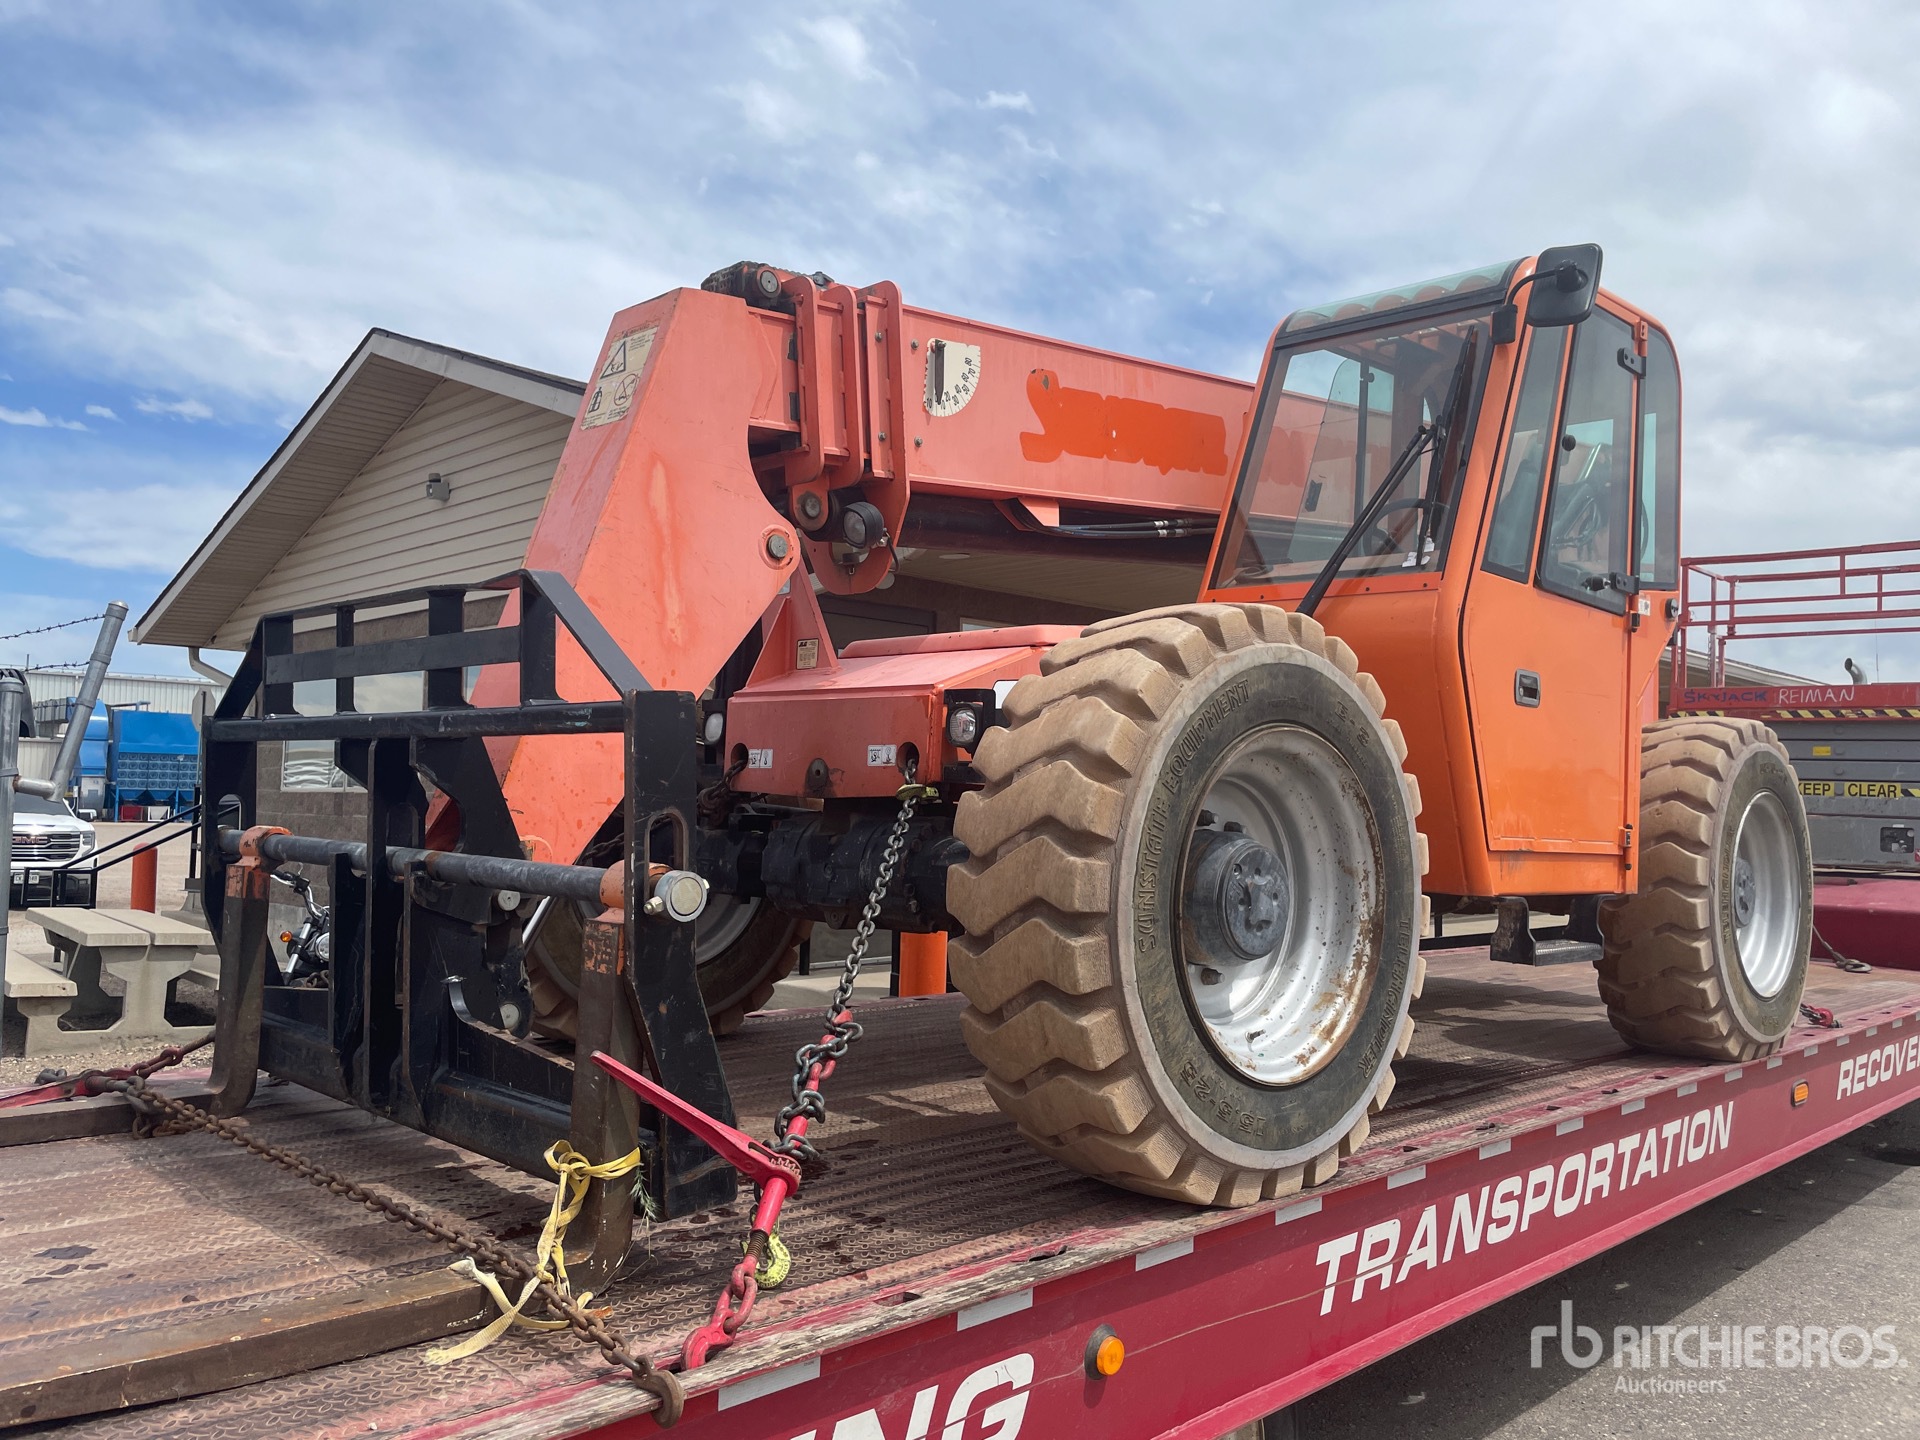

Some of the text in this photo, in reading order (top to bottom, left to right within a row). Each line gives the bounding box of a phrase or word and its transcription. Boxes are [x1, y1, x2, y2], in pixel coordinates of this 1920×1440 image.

[944, 391, 951, 402] 20
[1778, 686, 1855, 704] REIMAN
[1138, 679, 1251, 953] SUNSTATE EQUIPMENT
[1847, 783, 1898, 798] CLEAR
[1358, 917, 1412, 1078] TELEHANDLER
[1836, 1034, 1920, 1101] RECOVE
[1315, 1101, 1734, 1316] TRANSPORTATION
